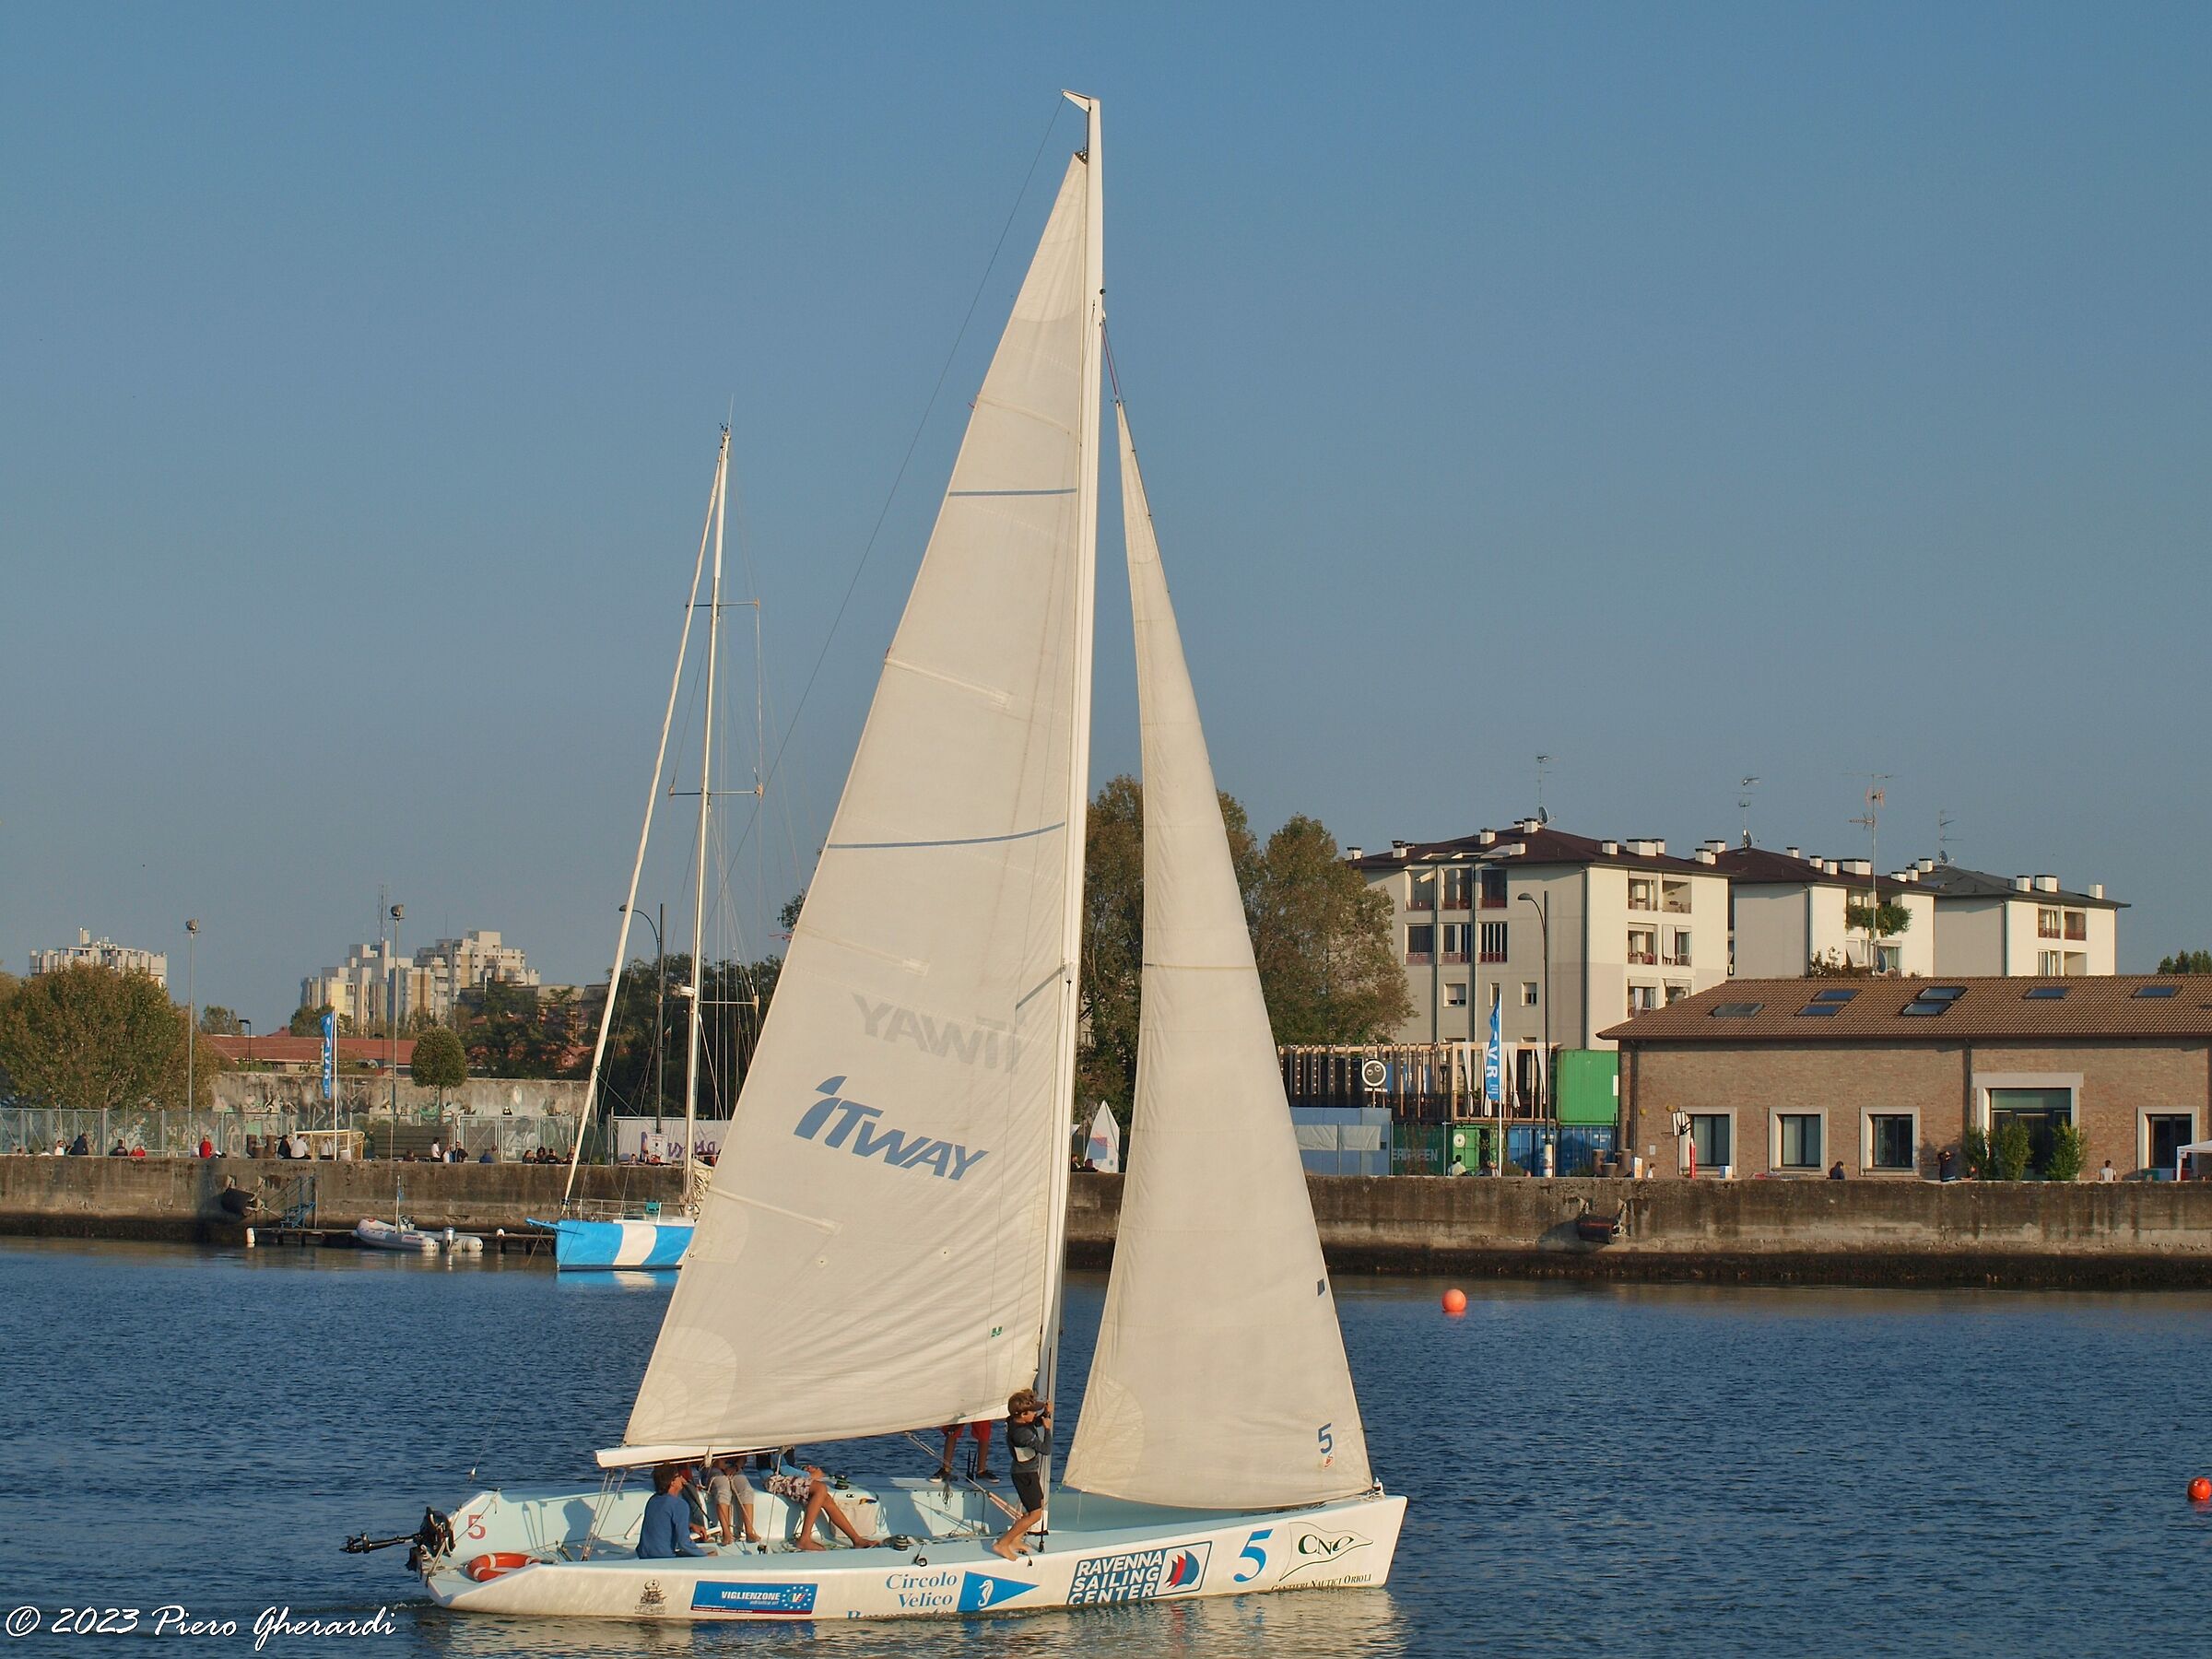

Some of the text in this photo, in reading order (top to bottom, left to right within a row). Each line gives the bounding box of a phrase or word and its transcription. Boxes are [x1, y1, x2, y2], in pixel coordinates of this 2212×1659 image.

[1317, 1422, 1334, 1454] 5
[467, 1515, 486, 1540] 5
[1077, 1550, 1163, 1577] RAVENNA
[1232, 1528, 1274, 1583] 5
[885, 1571, 958, 1590] Circolo
[1072, 1566, 1160, 1593] SAILING
[721, 1591, 781, 1601] VIGLIENZONE
[898, 1591, 953, 1608] Velico
[1068, 1583, 1156, 1606] CENTER
